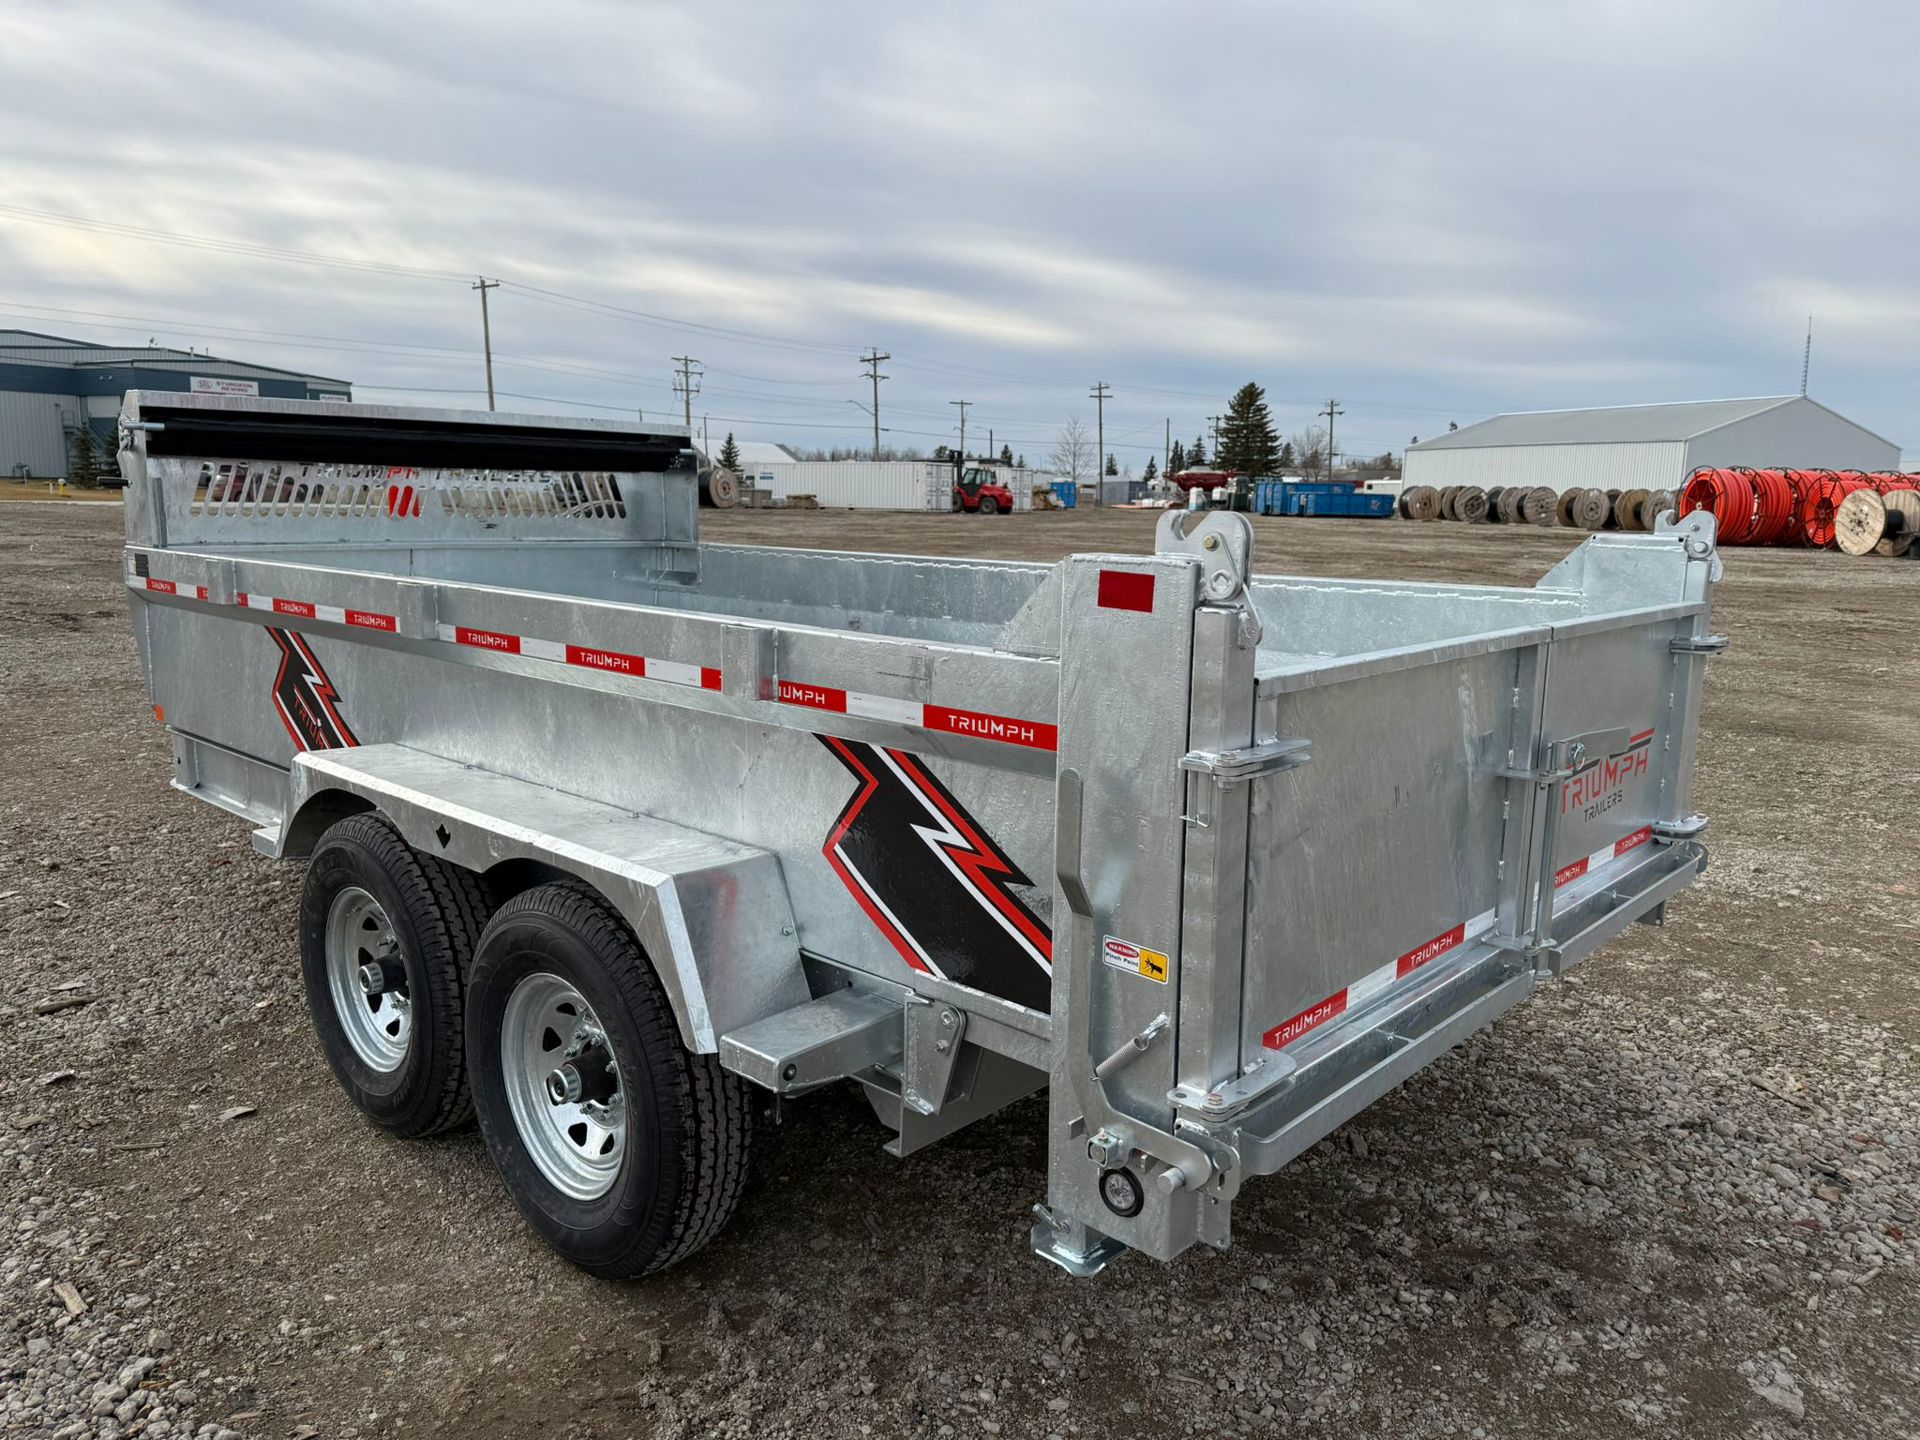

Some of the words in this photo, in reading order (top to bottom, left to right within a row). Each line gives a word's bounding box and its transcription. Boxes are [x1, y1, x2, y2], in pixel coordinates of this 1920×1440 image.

[280, 602, 308, 616] TRIUMPH
[353, 614, 387, 628] TRIUMPH
[467, 632, 508, 649] TRIUMPH
[580, 652, 629, 670] TRIUMPH
[948, 714, 1034, 742] TRIUMPH
[1562, 749, 1648, 815] TRIUMPH
[1584, 790, 1623, 823] TRAILERS
[1622, 832, 1645, 850] TRIUMPH
[1105, 952, 1122, 961] Pinch
[1123, 958, 1139, 966] Point
[1108, 943, 1138, 957] WARNING
[1410, 934, 1453, 967] TRIUMPH
[1274, 1003, 1332, 1045] TRIUMPH
